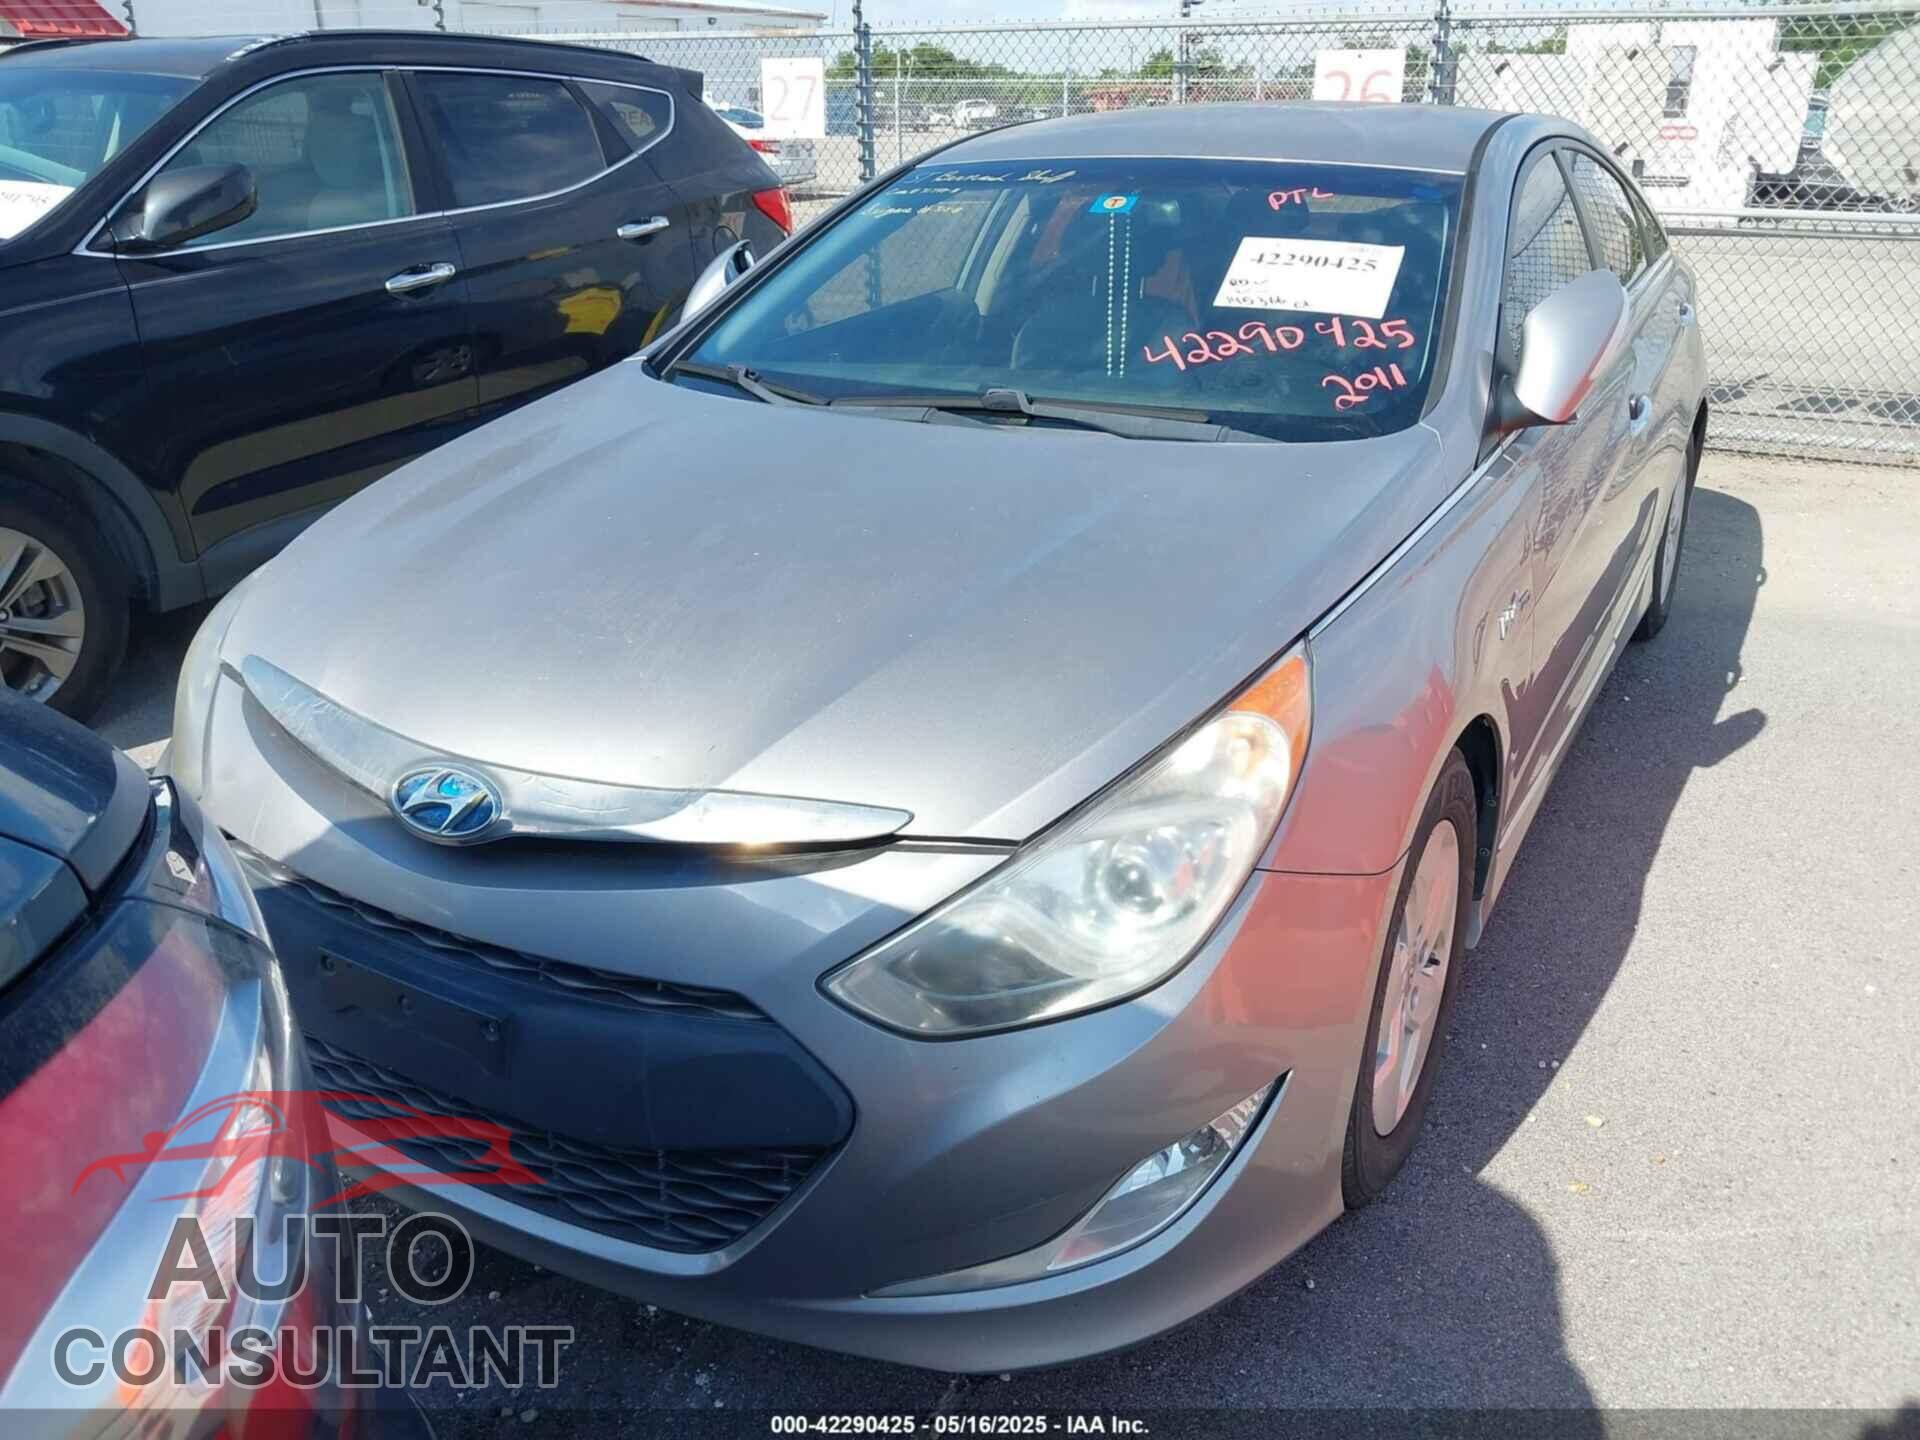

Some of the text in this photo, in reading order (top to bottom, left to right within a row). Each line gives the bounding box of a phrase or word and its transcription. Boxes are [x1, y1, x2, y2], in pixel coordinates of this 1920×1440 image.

[770, 75, 818, 121] 27
[1249, 251, 1379, 272] 42290425
[1321, 363, 1407, 412] 2011
